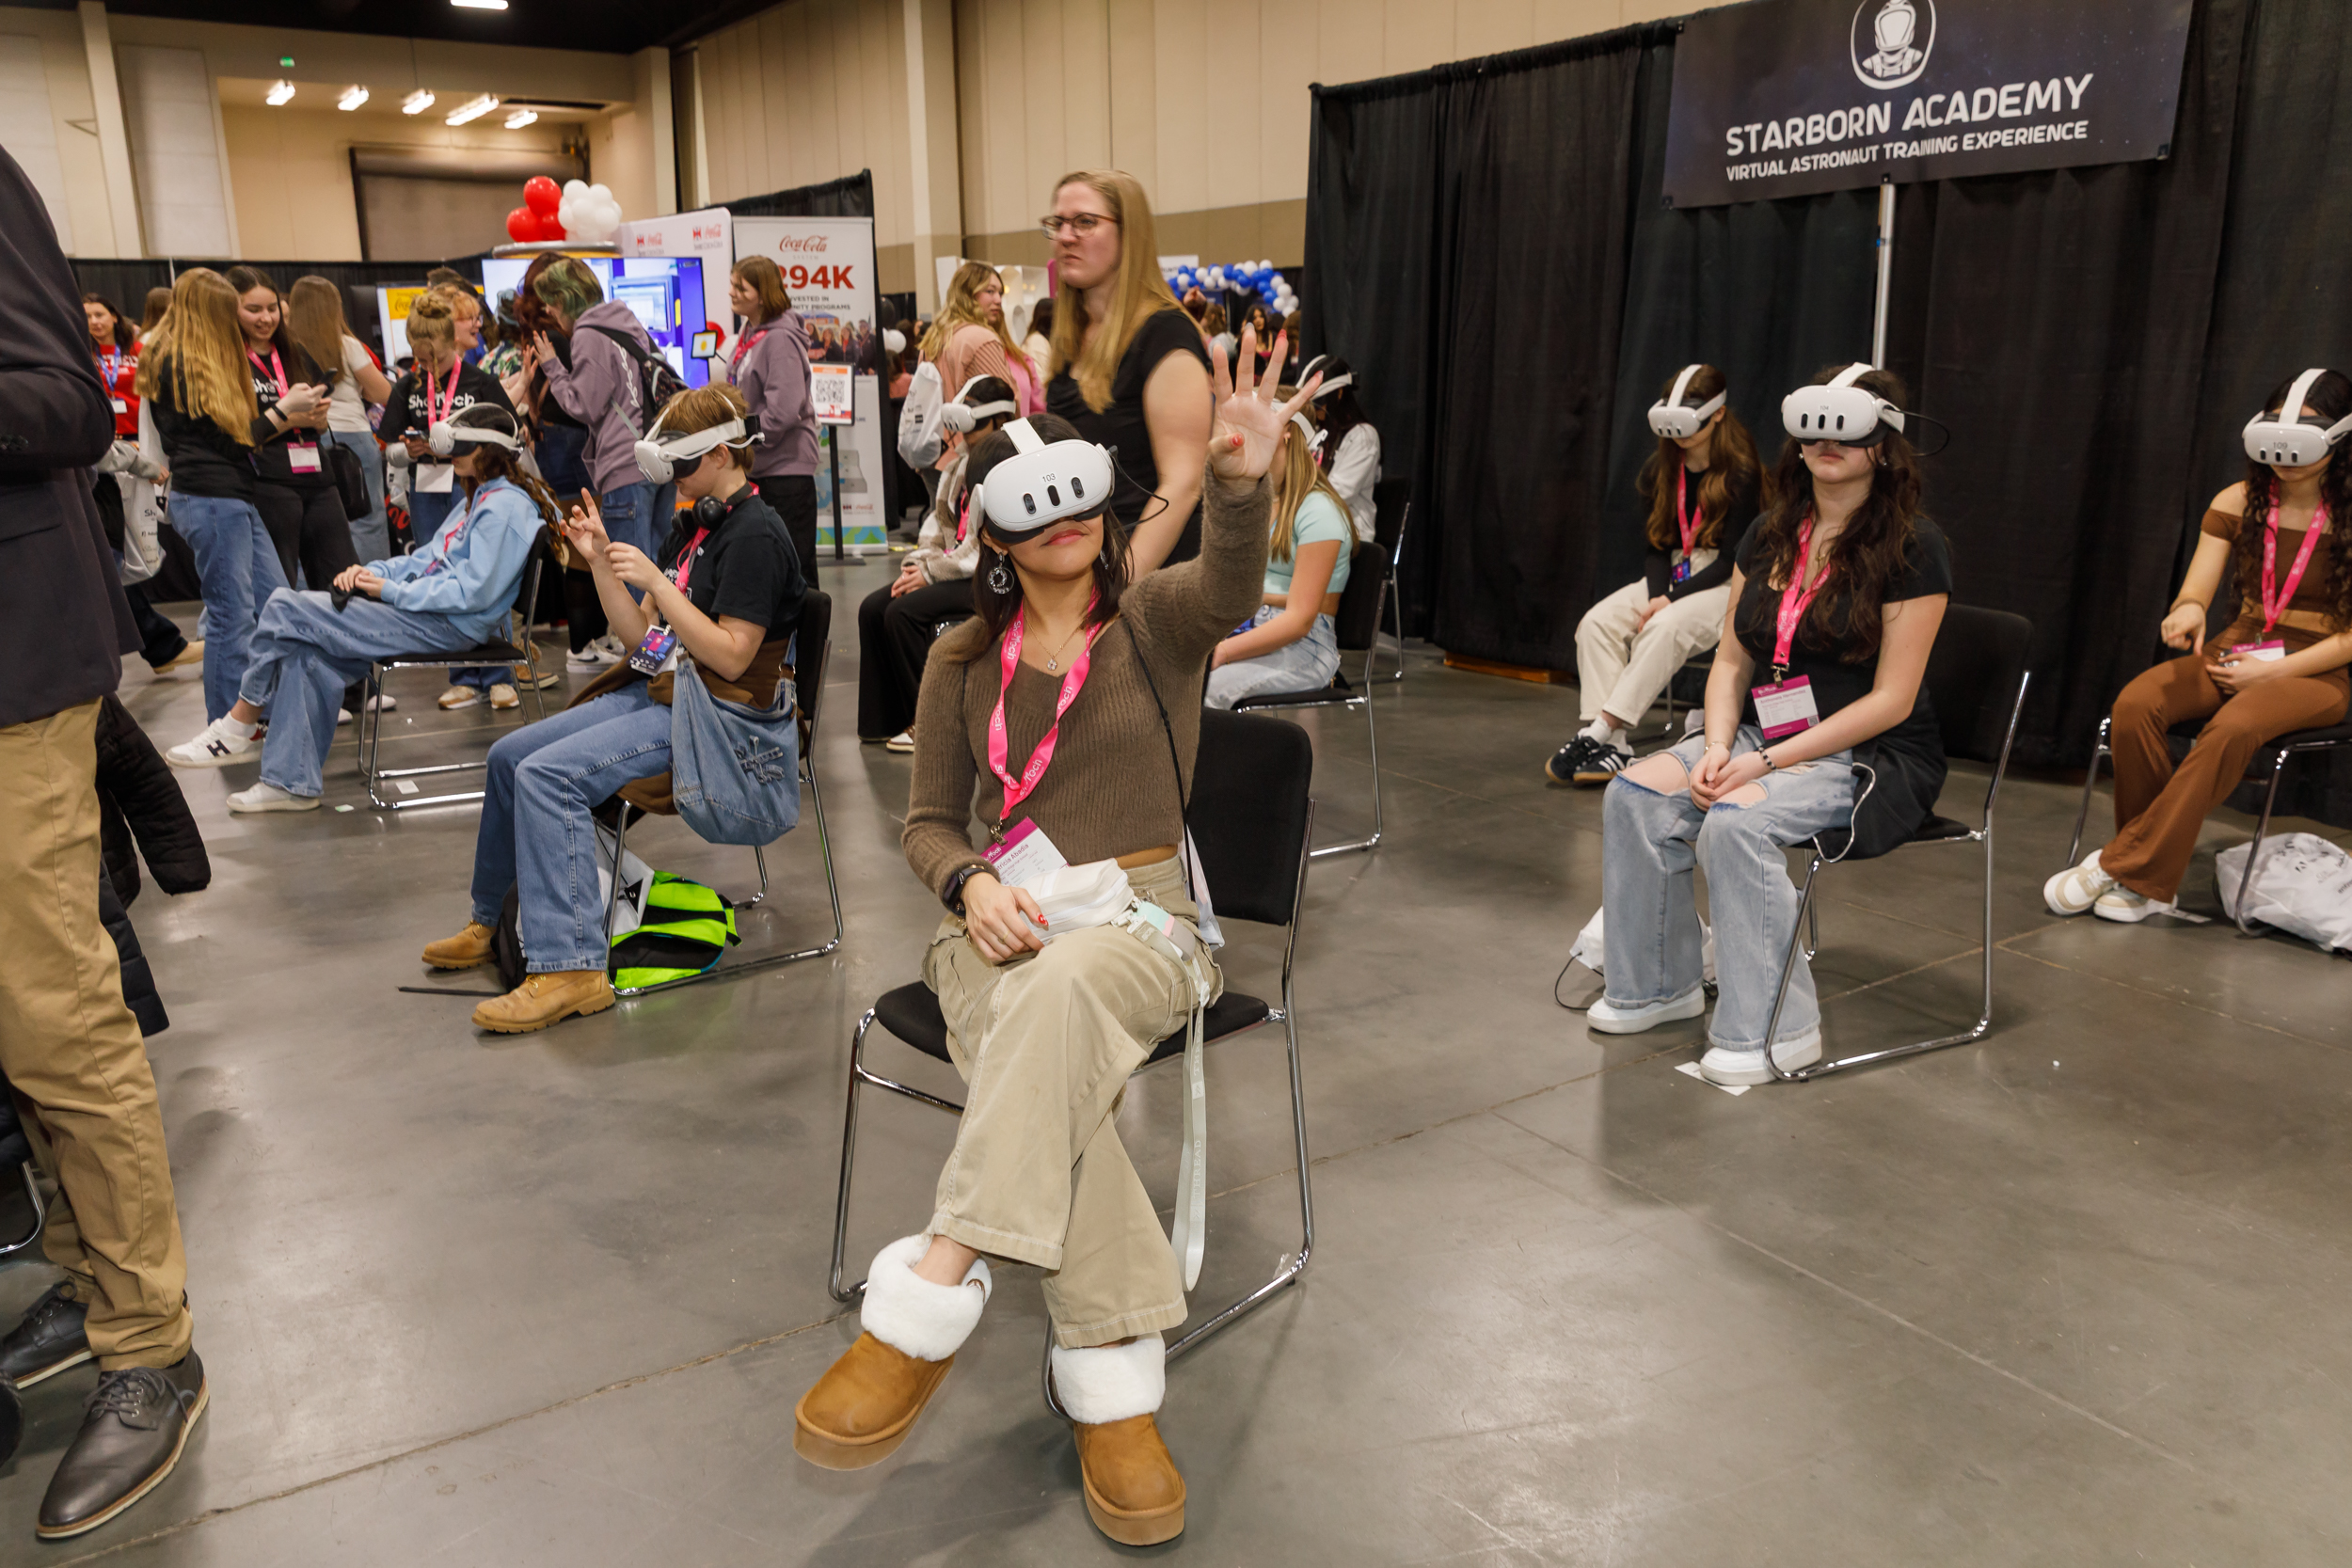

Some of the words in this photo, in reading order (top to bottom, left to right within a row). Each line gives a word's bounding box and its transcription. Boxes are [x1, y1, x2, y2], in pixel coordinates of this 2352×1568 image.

[1725, 101, 1892, 156] STARBORN
[1901, 73, 2094, 131] ACADEMY
[1725, 159, 1788, 182] VIRTUAL
[1789, 145, 1880, 174] ASTRONAUT
[1883, 135, 1959, 160] TRAINING
[1962, 120, 2089, 151] EXPERIENCE
[1042, 473, 1056, 483] 103
[1010, 843, 1029, 859] Abadia
[1193, 1140, 1202, 1198] THREAD
